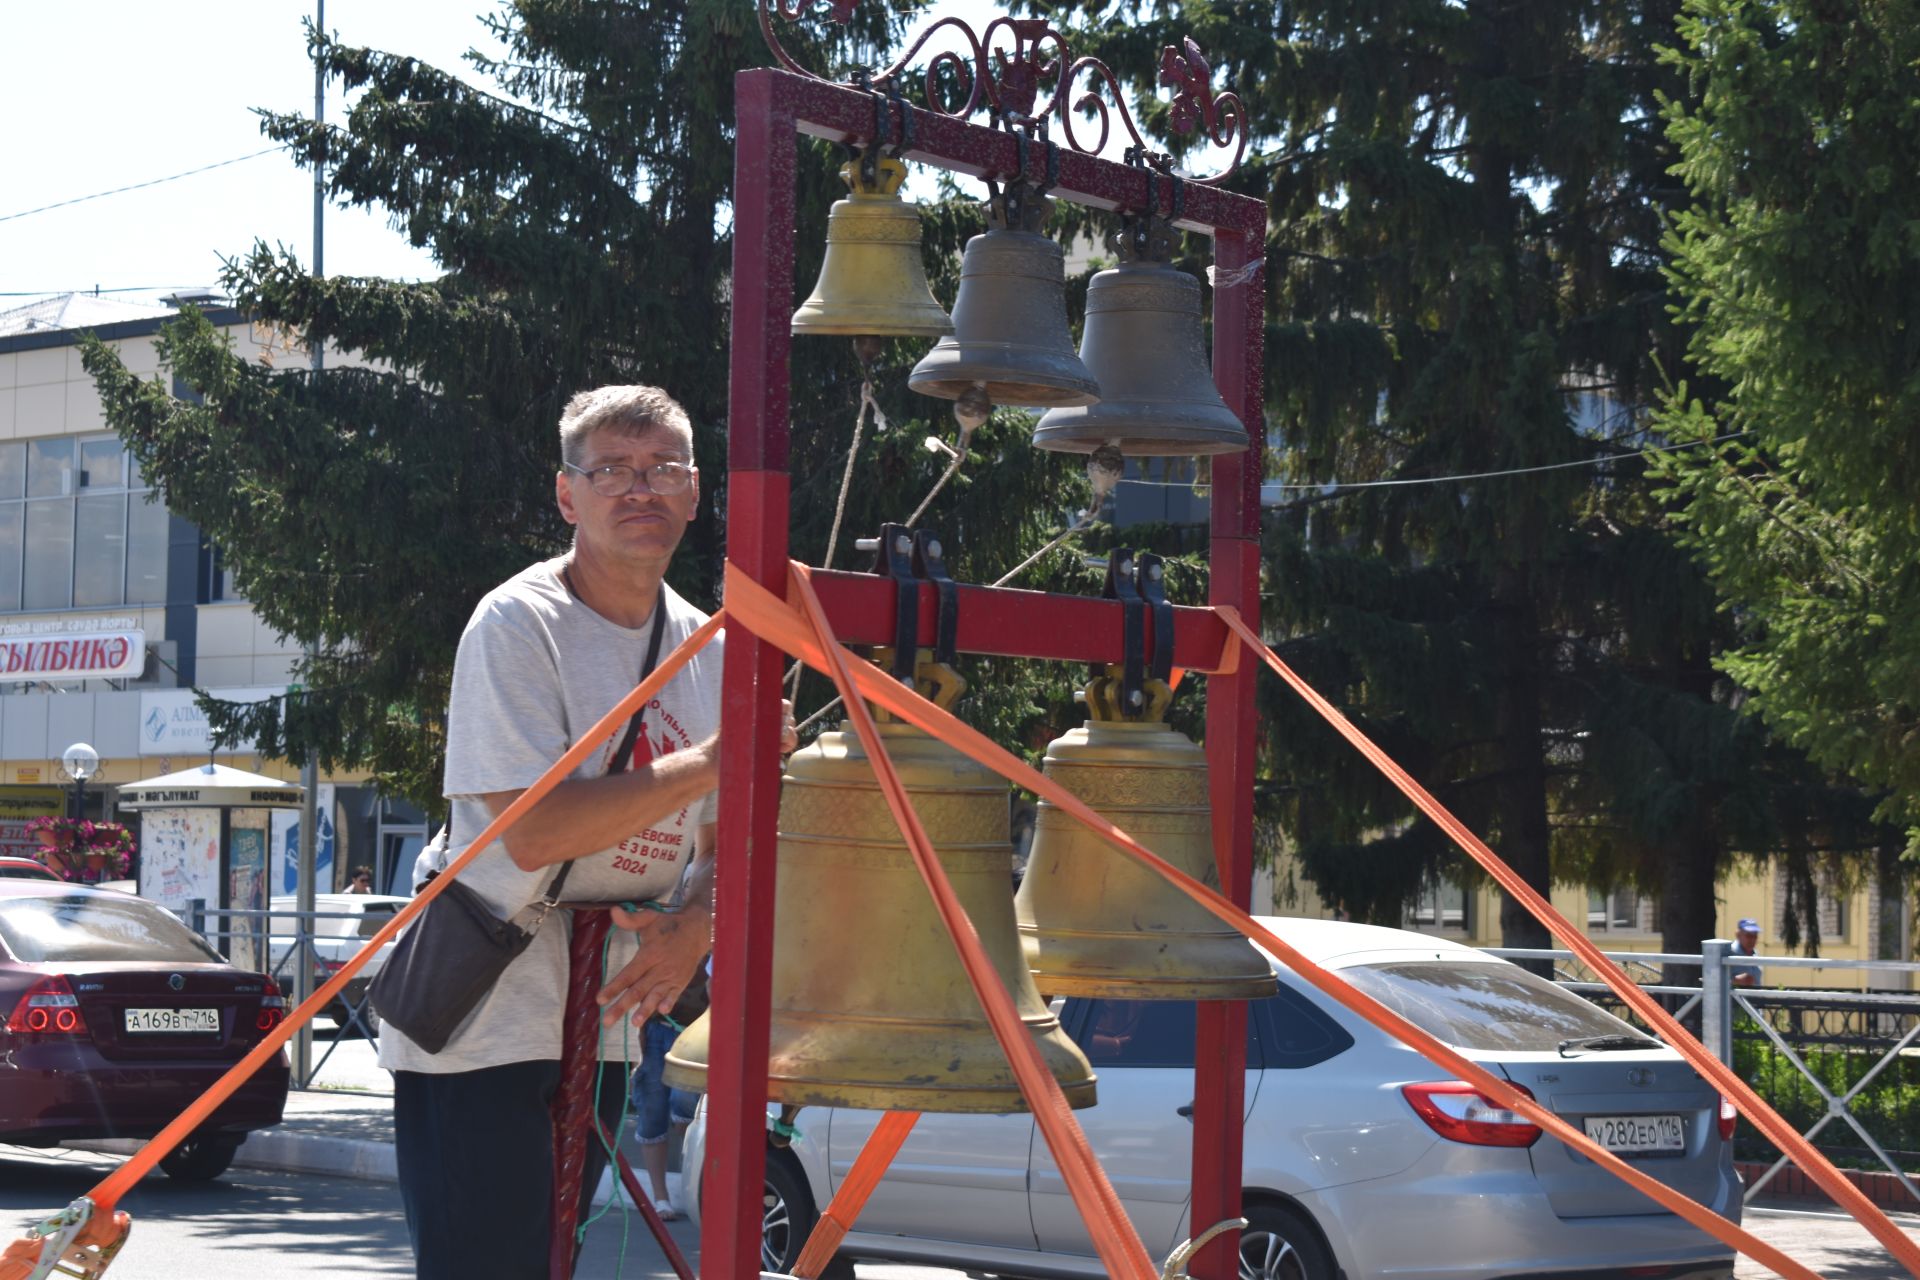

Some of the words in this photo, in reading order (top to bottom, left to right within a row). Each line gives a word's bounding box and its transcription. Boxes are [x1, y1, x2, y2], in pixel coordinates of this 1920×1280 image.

[33, 621, 62, 633] ЦЕНТР
[634, 829, 683, 846] ЕВСКИЕ
[612, 855, 647, 876] 2024
